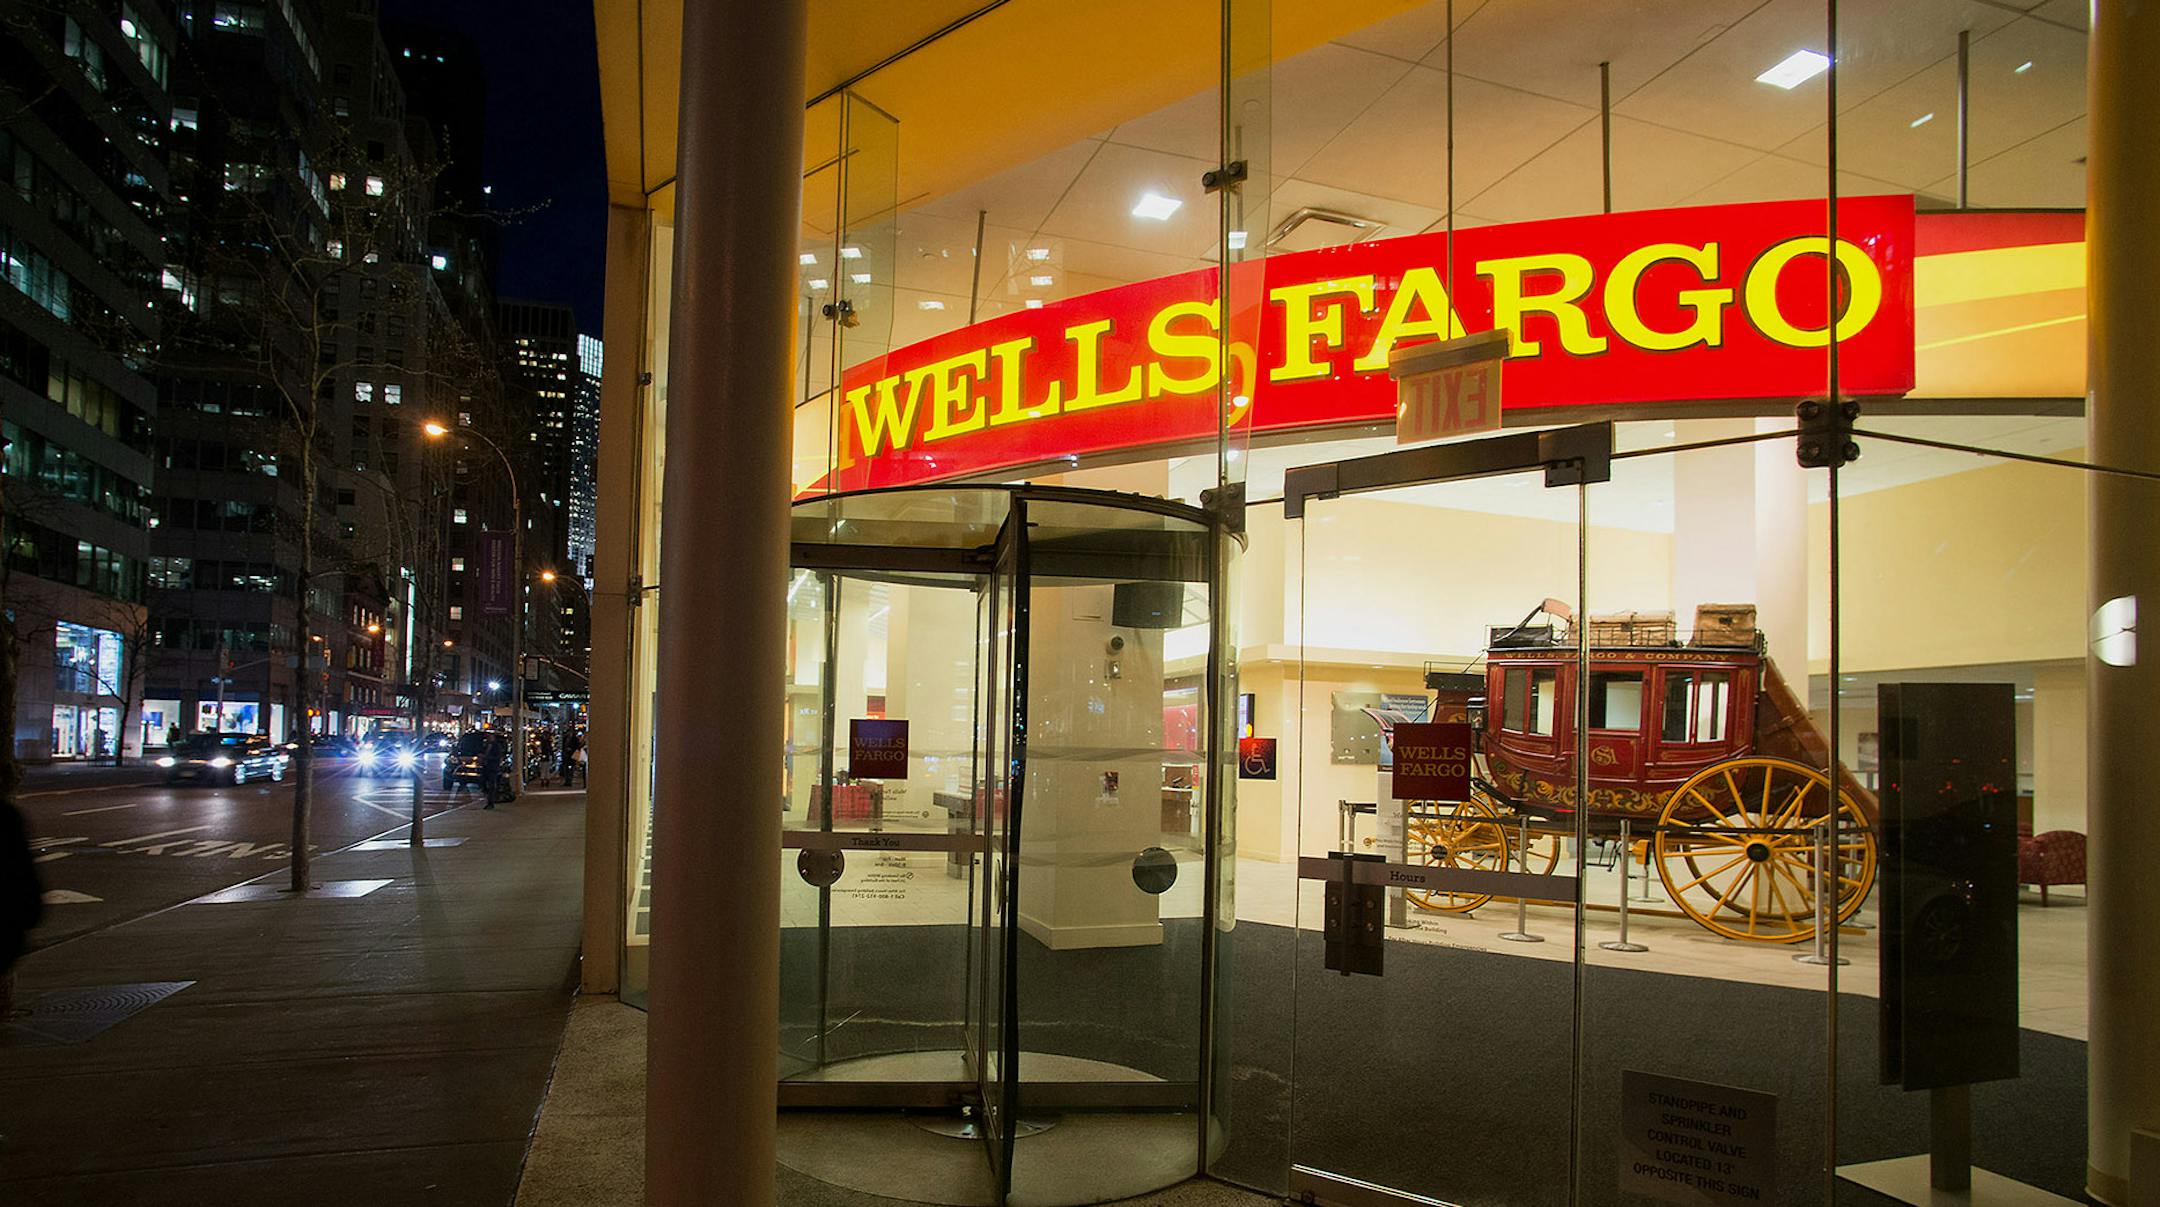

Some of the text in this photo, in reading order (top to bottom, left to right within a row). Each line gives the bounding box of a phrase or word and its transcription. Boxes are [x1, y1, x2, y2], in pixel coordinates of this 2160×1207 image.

[847, 234, 1882, 458] WELLS FARGO
[1625, 652, 1635, 660] &
[1645, 652, 1729, 661] COMPANY
[854, 736, 905, 749] WELLS
[855, 750, 905, 762] FARGO
[1398, 746, 1466, 761] WELLS
[1400, 762, 1466, 778] FARGO
[851, 837, 900, 847] Thank You
[1389, 870, 1426, 883] Hours
[1648, 1092, 1747, 1121] STANDPIPE AND
[1661, 1113, 1732, 1137] SPRINKLER
[1647, 1128, 1747, 1159] CONTROL VALVE
[1655, 1149, 1712, 1171] LOCATED
[1633, 1162, 1761, 1200] OPPOSITE THIS SIGN
